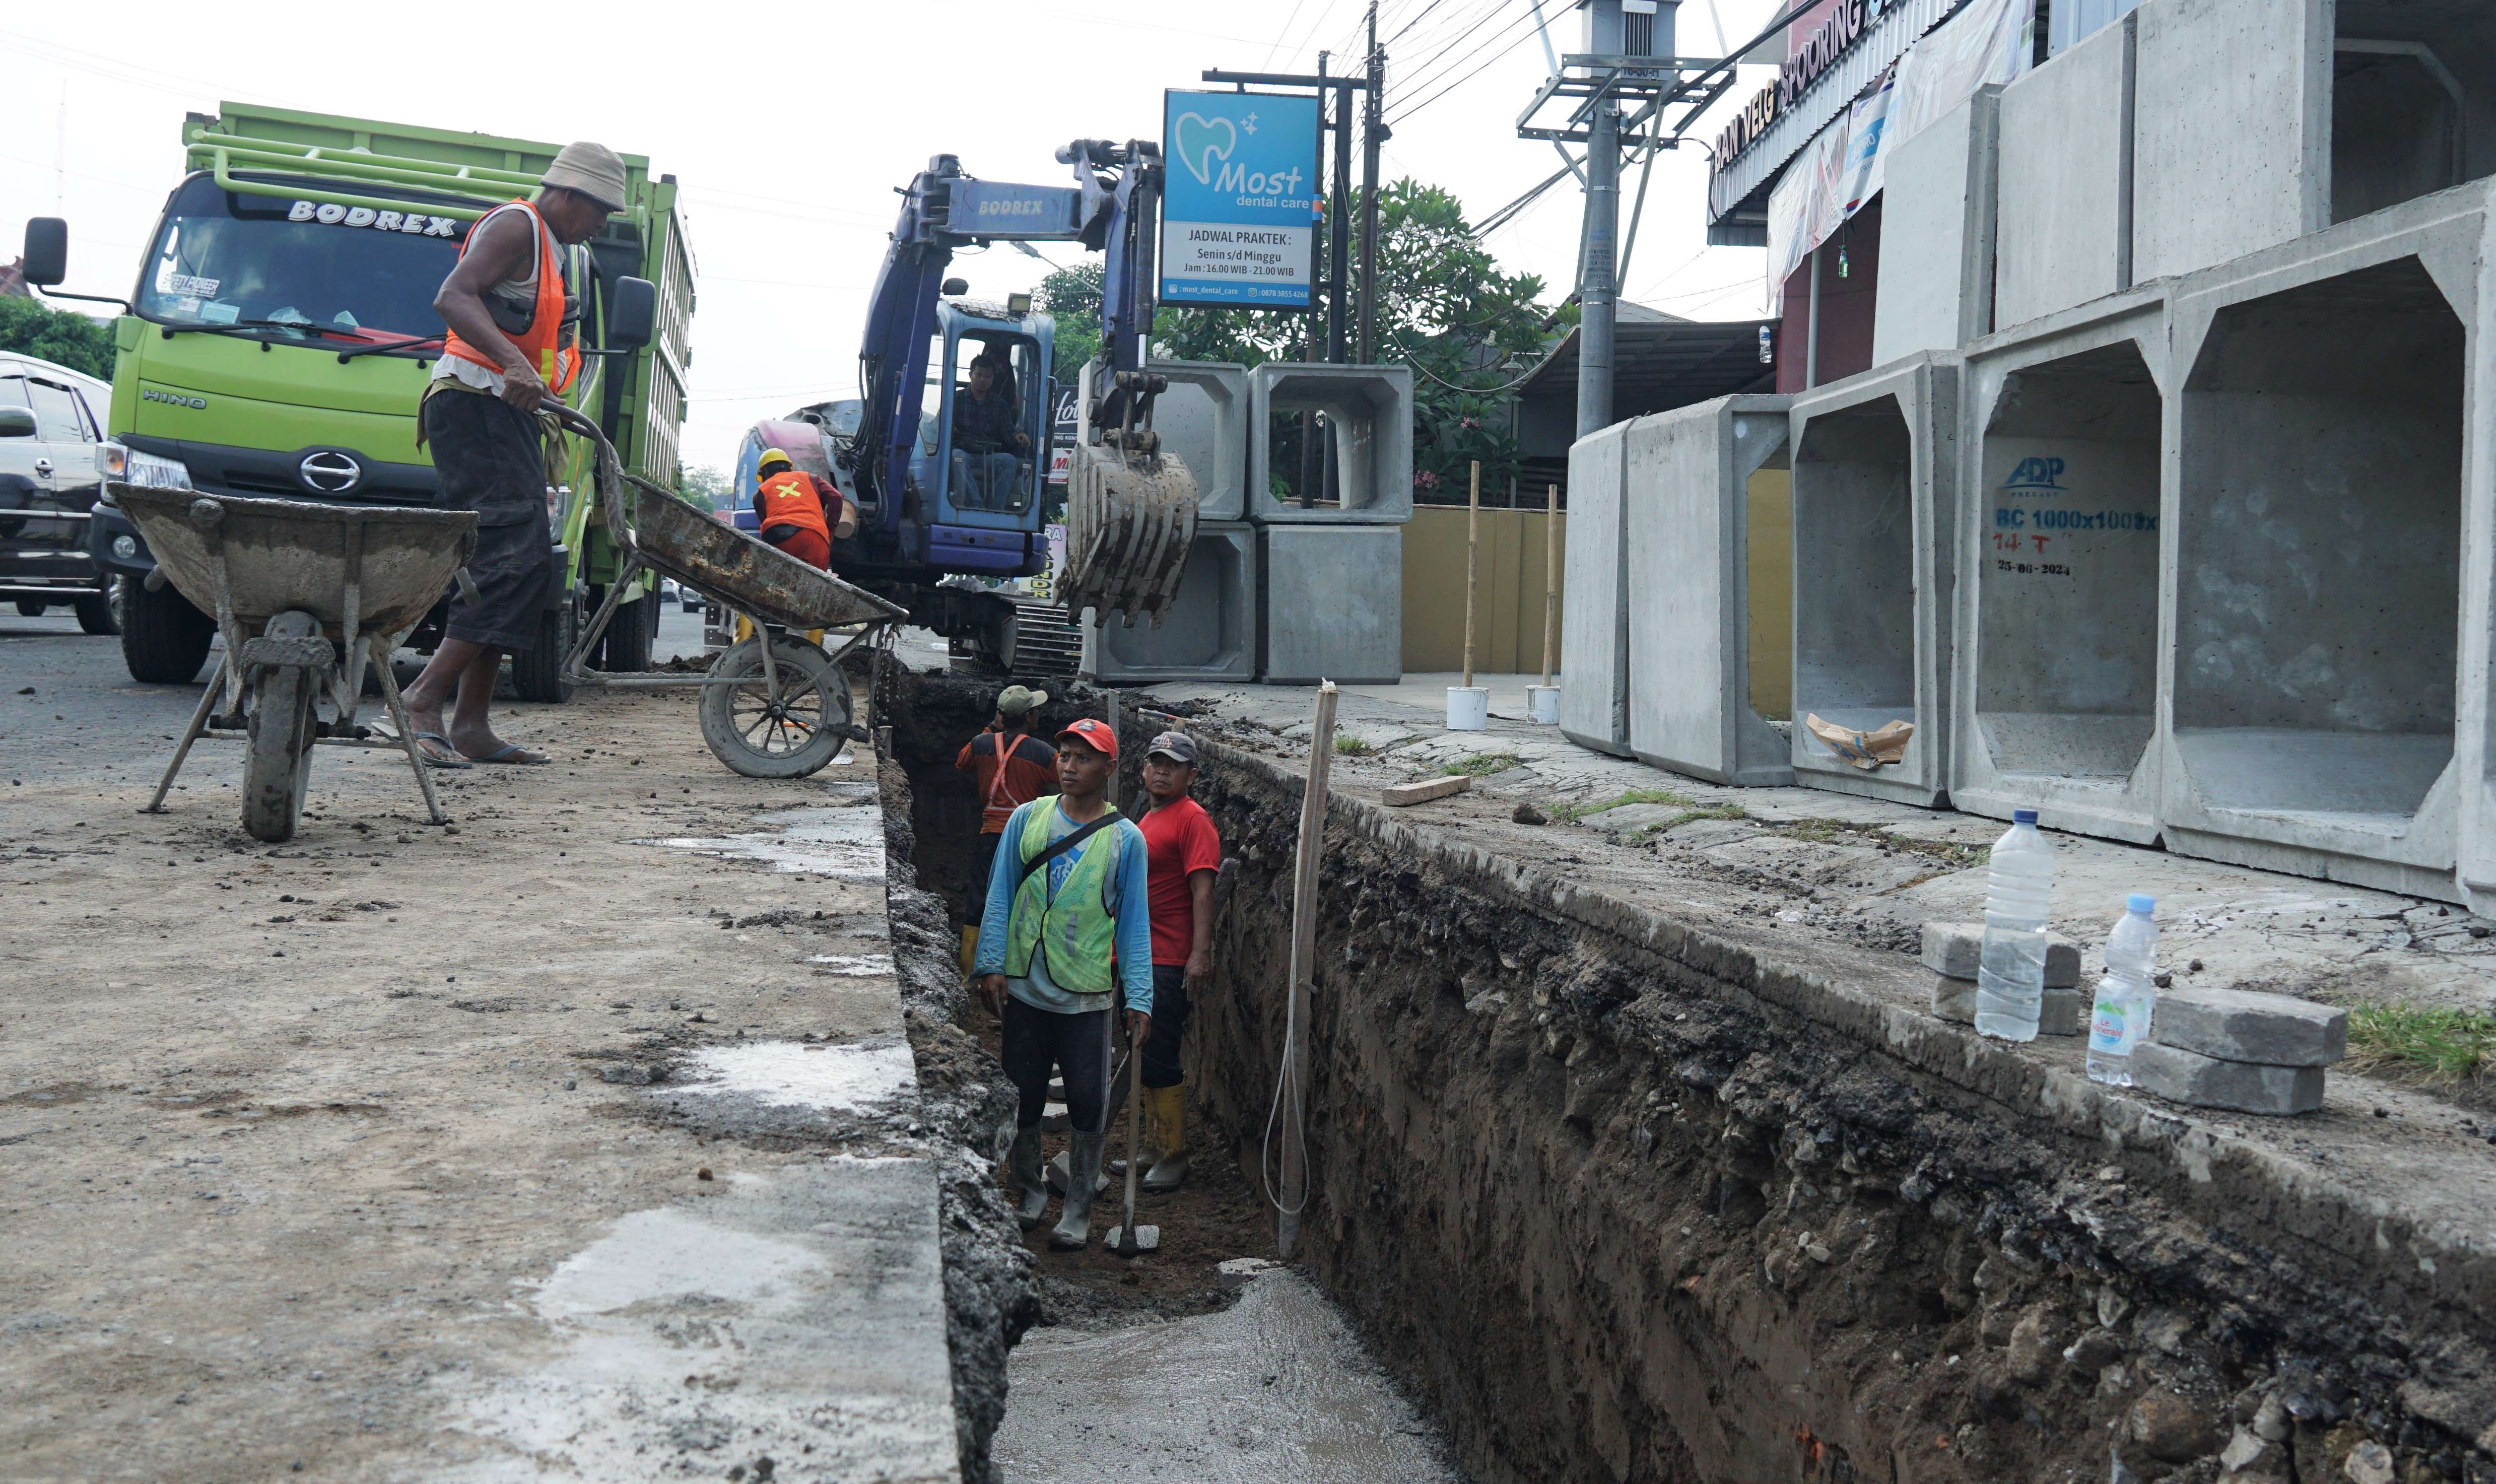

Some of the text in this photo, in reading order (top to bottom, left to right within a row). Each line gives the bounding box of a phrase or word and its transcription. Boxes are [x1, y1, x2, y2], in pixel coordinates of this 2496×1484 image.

[1715, 0, 1861, 174] BAN VELG SPOORING
[1214, 162, 1303, 194] Most
[978, 200, 1043, 216] BODREX
[1237, 195, 1310, 209] dental care
[288, 200, 456, 237] BODREX
[1189, 230, 1234, 242] JADWAL
[1236, 232, 1287, 245] PRAKTEK
[1197, 248, 1281, 264] Senin s/d Minggu
[1184, 263, 1201, 272] Jam
[1207, 264, 1229, 273] 16.00
[1230, 265, 1247, 274] WIB
[1253, 266, 1275, 275] 21.00
[1277, 267, 1294, 276] WIB
[143, 389, 207, 410] HINO
[2004, 457, 2065, 485] ADP
[1996, 508, 2025, 529] BC
[1993, 533, 2052, 554] 14 T
[2101, 1017, 2110, 1027] Le
